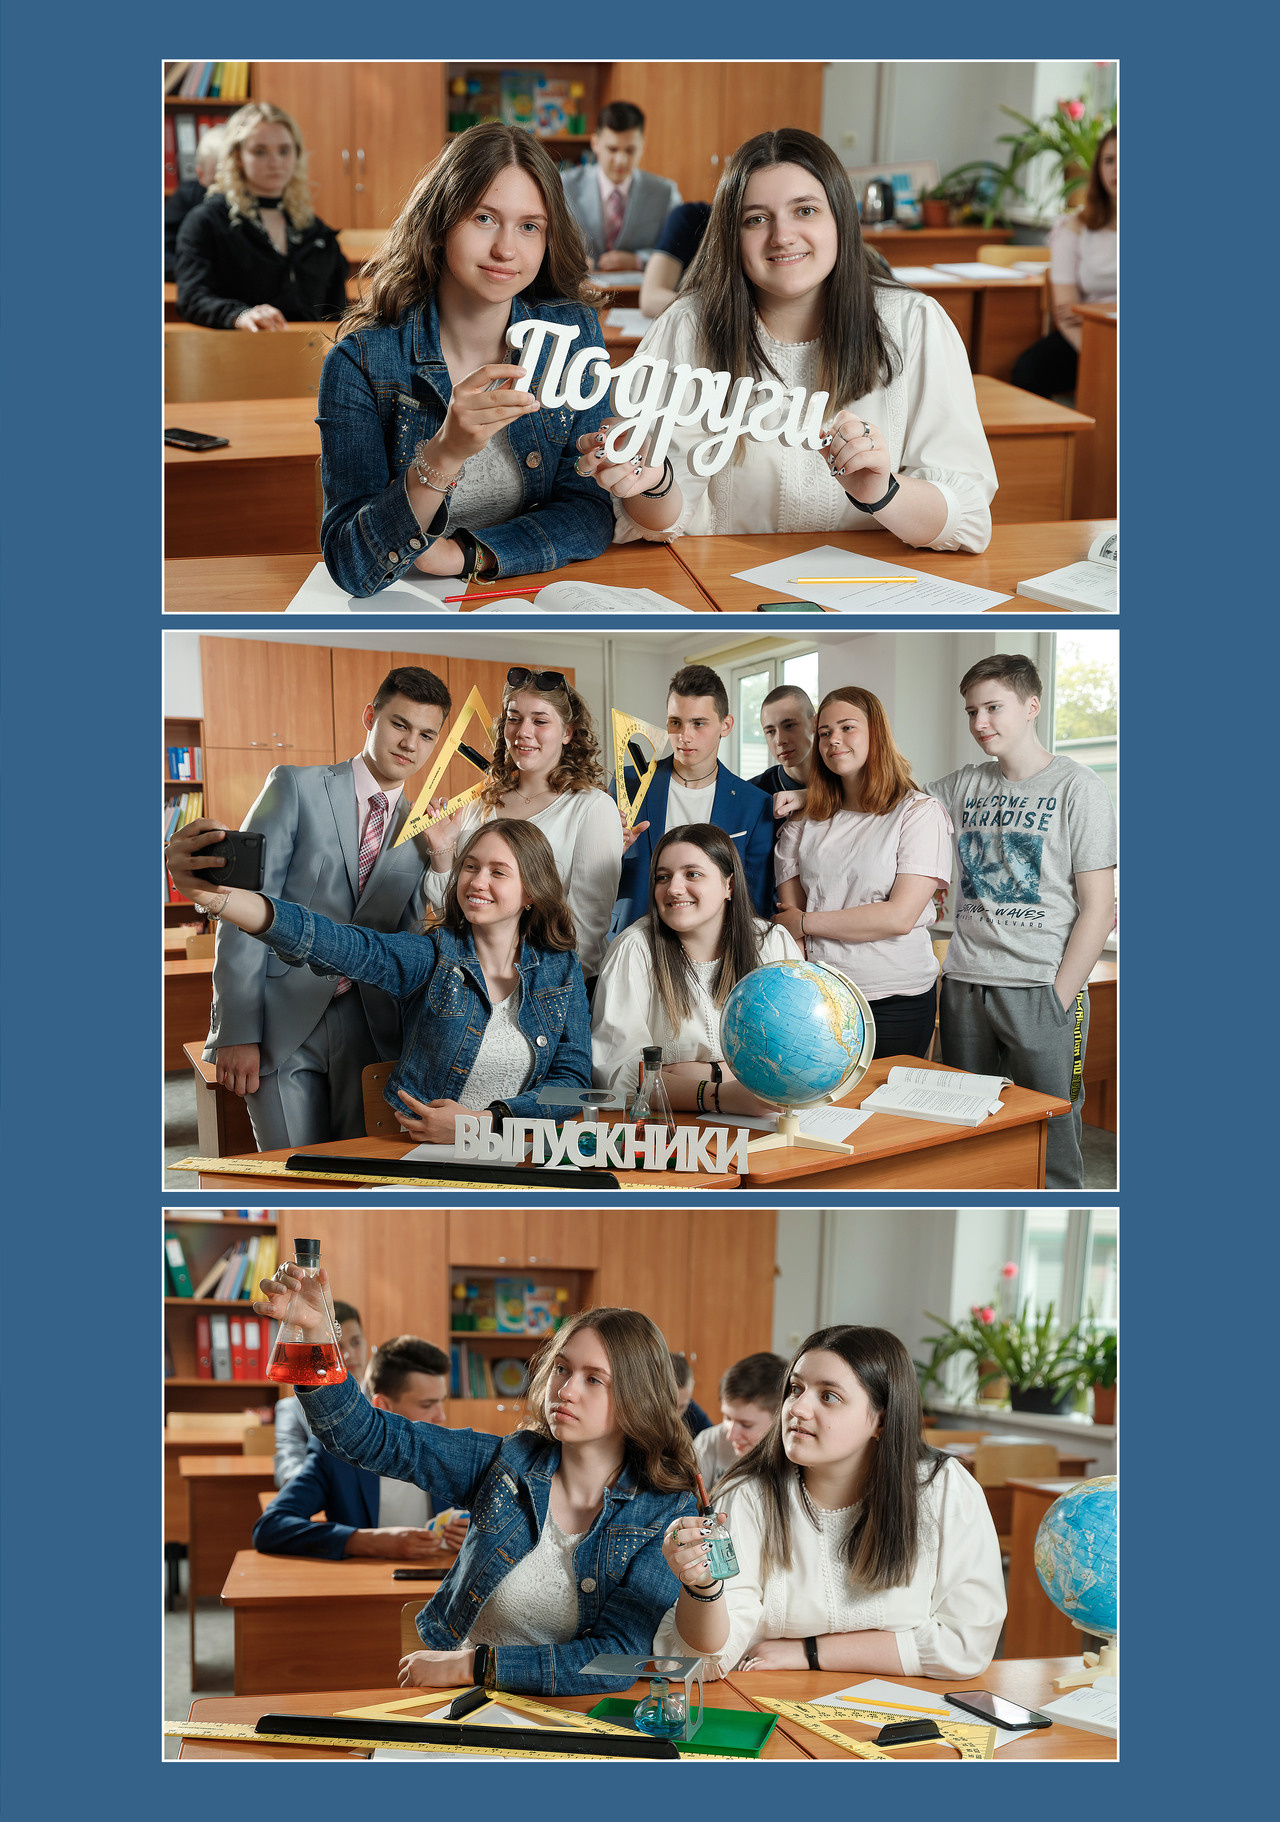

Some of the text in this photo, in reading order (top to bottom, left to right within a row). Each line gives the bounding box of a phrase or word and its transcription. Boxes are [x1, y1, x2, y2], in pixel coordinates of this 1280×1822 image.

[506, 318, 830, 477] Подруги
[965, 795, 1057, 811] WELCOME TO
[961, 810, 1053, 832] PARADISE
[995, 906, 1046, 920] WAVES
[979, 916, 1043, 929] BOULEVARD
